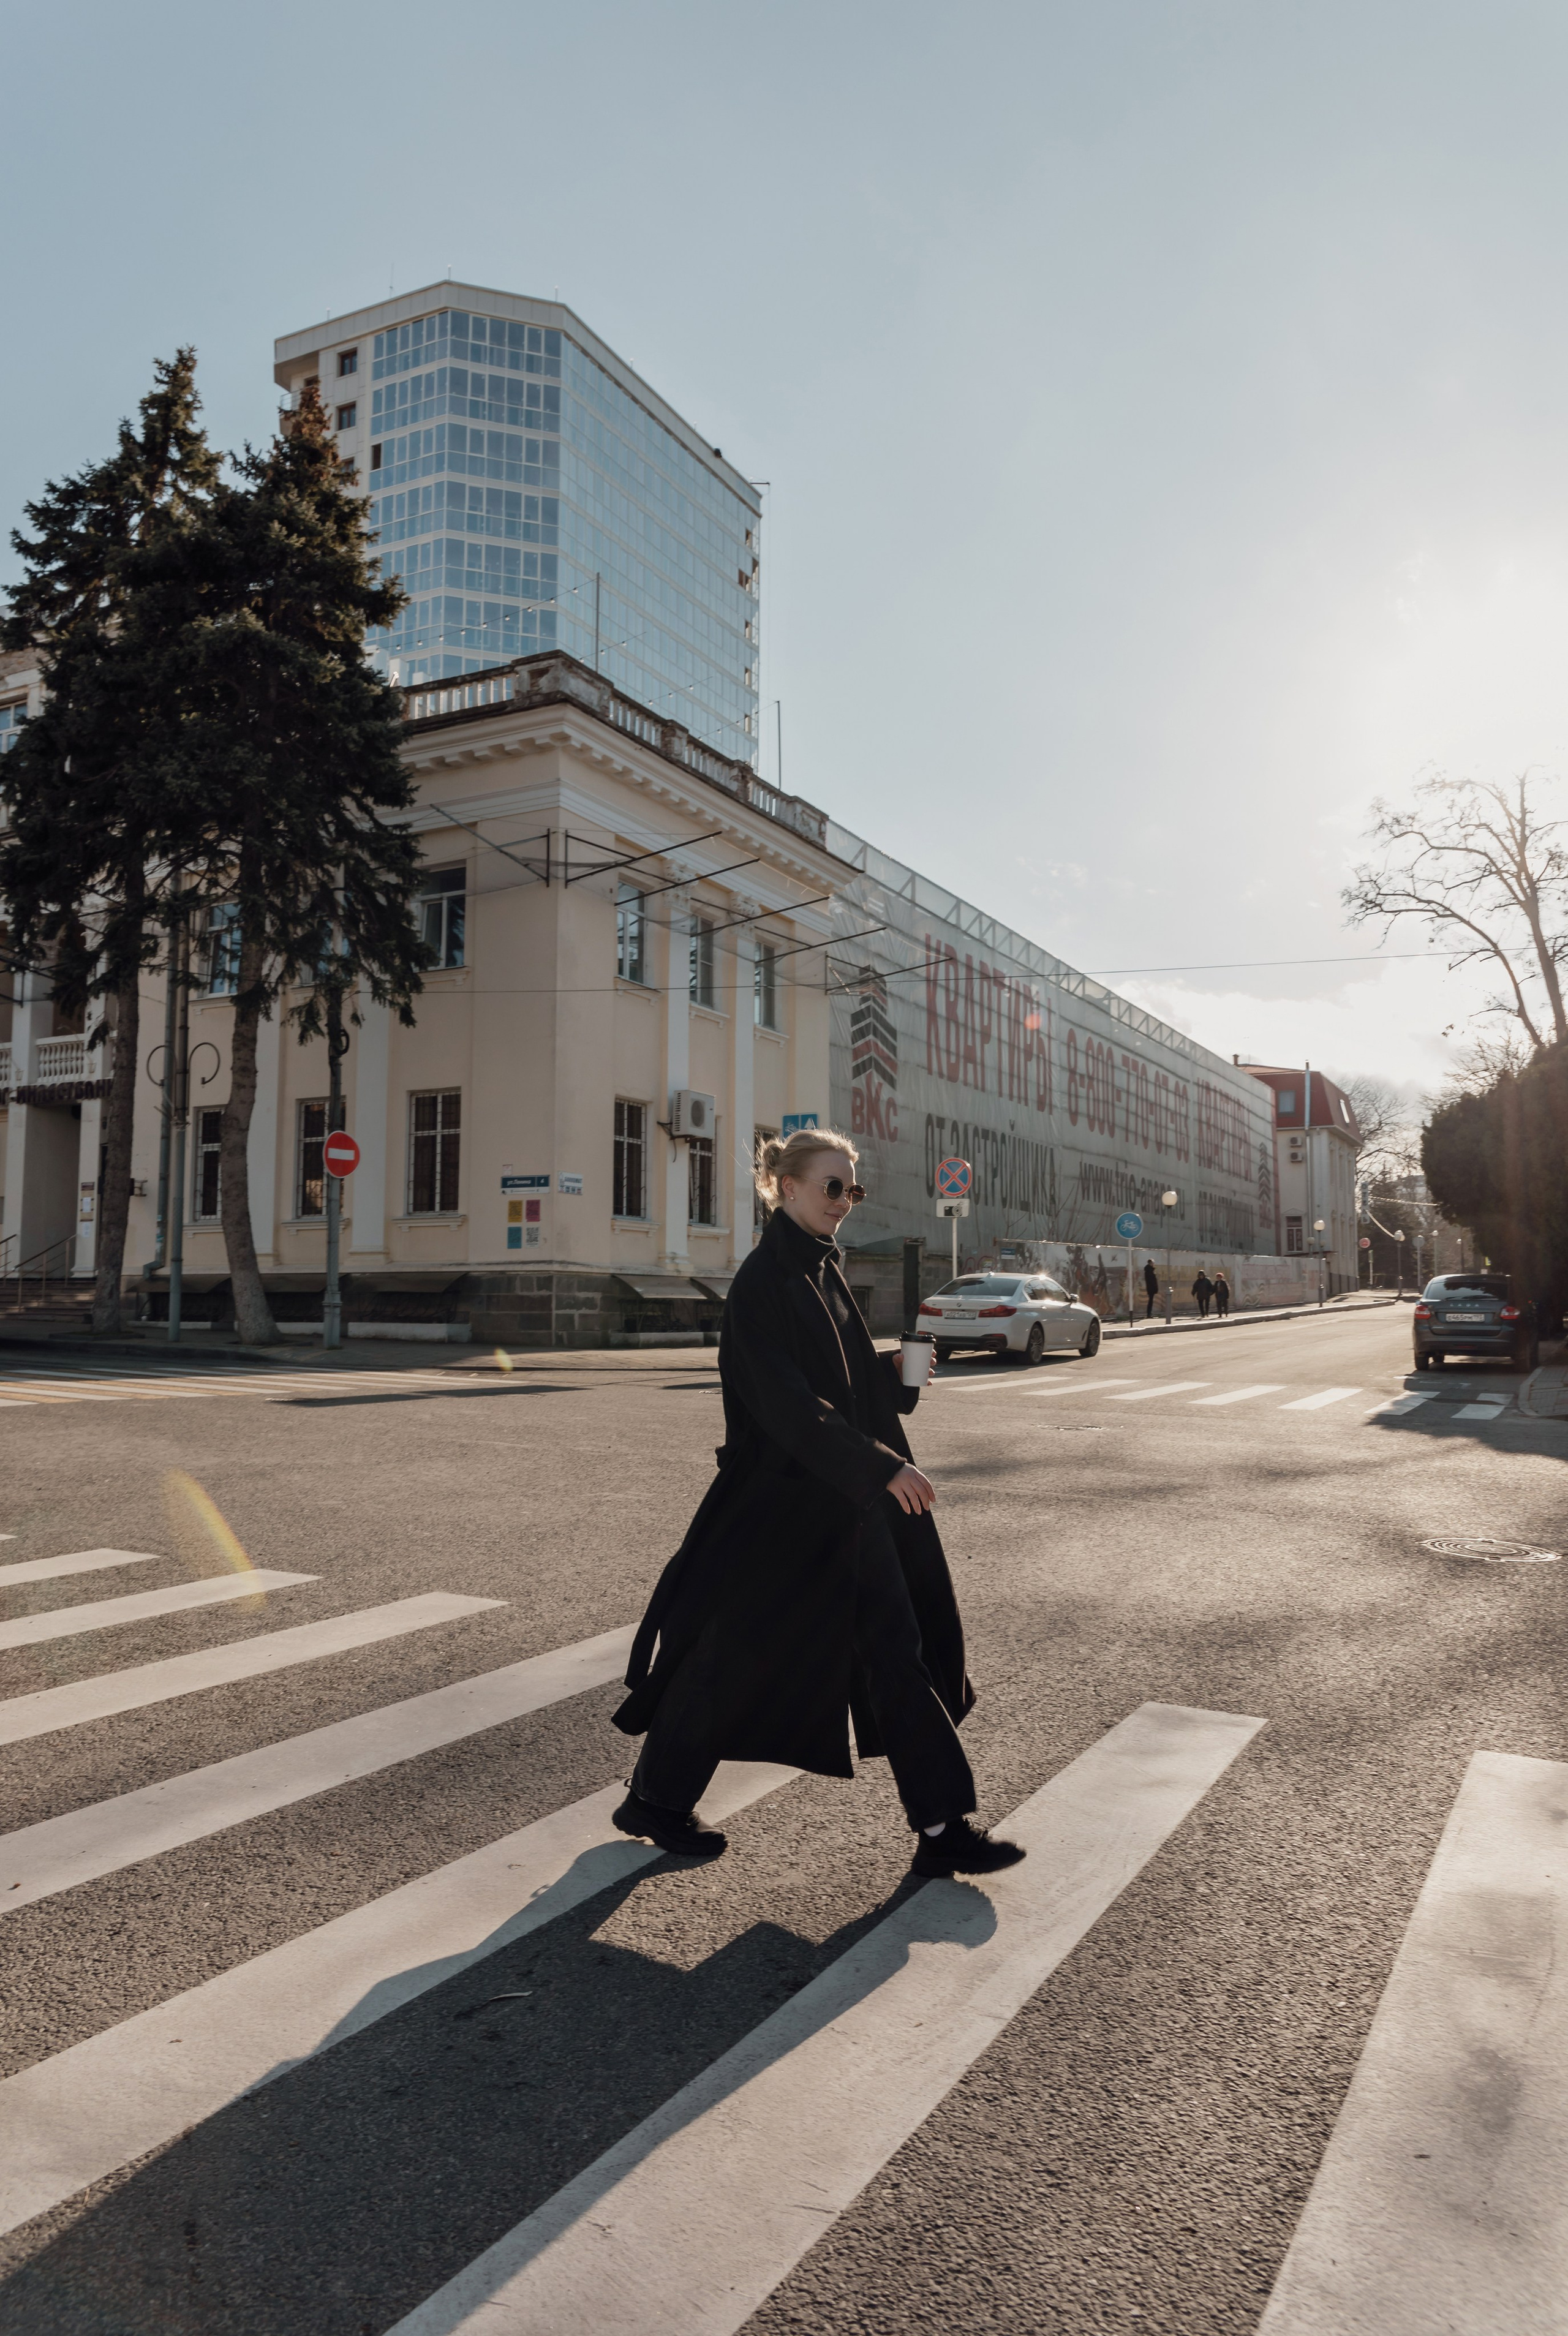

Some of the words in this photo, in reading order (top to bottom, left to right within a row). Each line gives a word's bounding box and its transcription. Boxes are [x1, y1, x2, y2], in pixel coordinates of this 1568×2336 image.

[925, 933, 1053, 1115] КВАРТИРЫ
[851, 1071, 899, 1143] ВКС
[1066, 1028, 1189, 1164] 8-800-770-07-03
[1197, 1076, 1253, 1183] КВАРТИРЫ
[924, 1112, 946, 1199] ОТ
